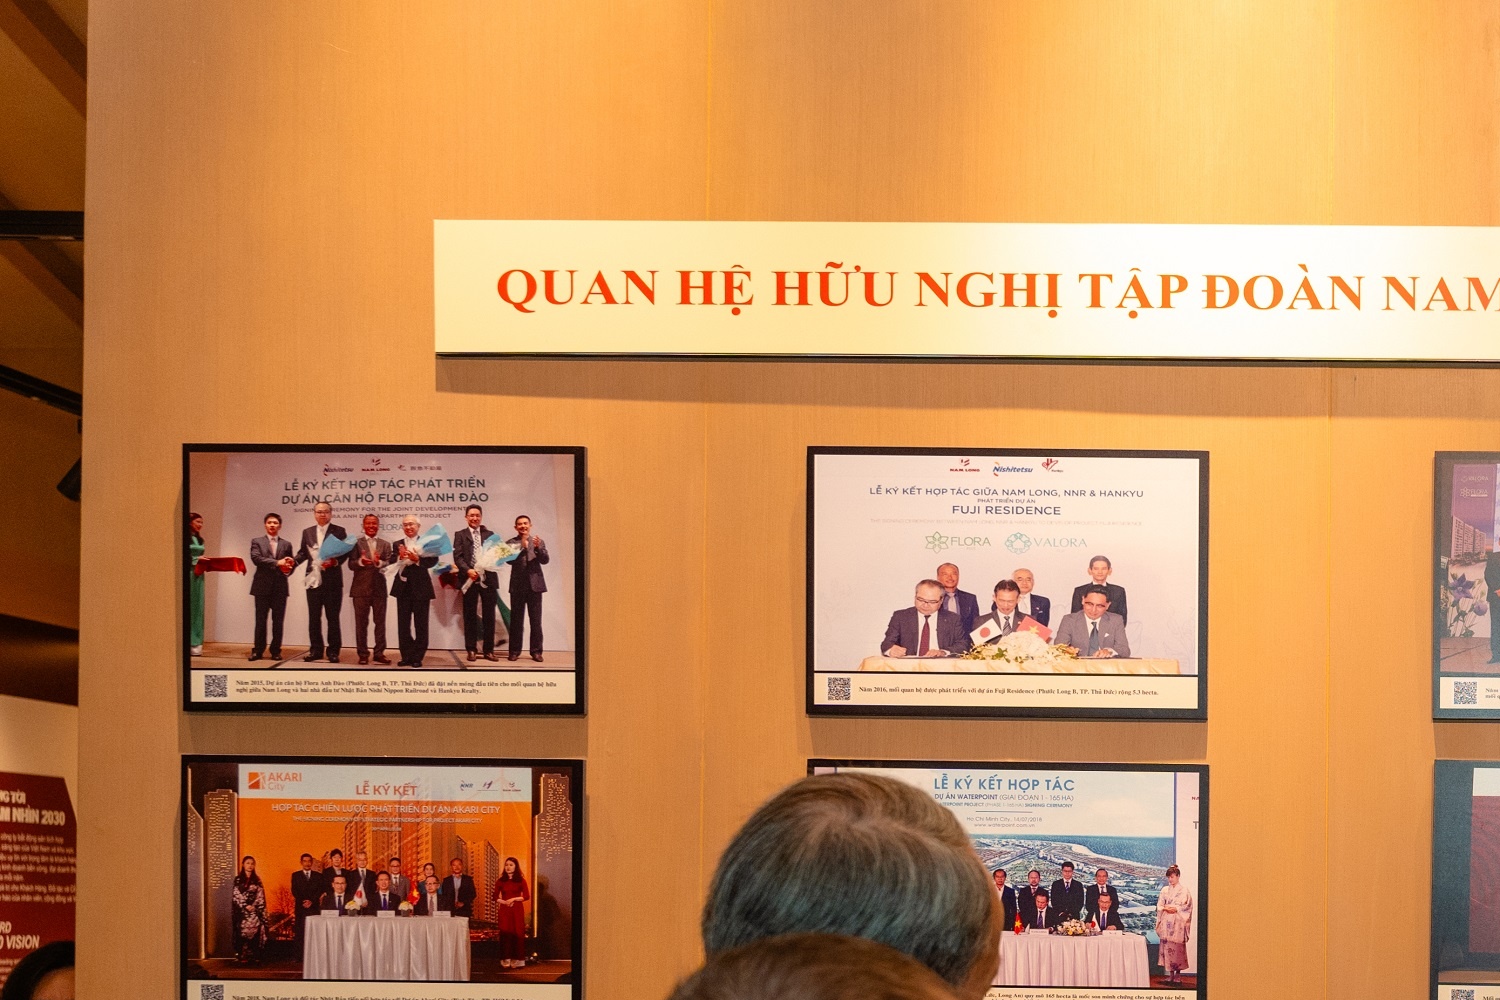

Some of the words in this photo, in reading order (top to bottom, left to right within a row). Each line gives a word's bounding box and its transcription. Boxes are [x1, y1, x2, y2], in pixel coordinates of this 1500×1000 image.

[497, 269, 659, 313] QUAN
[676, 264, 754, 316] HỆ
[771, 262, 898, 307] HỮU
[914, 271, 1063, 318] NGHỊ
[1078, 268, 1189, 318] TẬP
[1202, 264, 1365, 311] ĐOÀN
[993, 466, 1033, 474] Nishitetsu
[284, 478, 299, 491] LỄ
[302, 479, 318, 490] KÝ
[322, 478, 345, 490] KẾT
[349, 481, 376, 492] HỢP
[380, 478, 405, 489] TÁC
[409, 478, 442, 489] PHÁT
[447, 476, 486, 488] TRIỂN
[869, 485, 882, 494] LỄ
[885, 486, 899, 495] KÝ
[902, 485, 922, 495] KẾT
[925, 488, 948, 497] HỢP
[950, 486, 970, 495] TÁC
[972, 487, 998, 496] GIỮA
[1029, 489, 1060, 497] LONG,
[282, 495, 300, 506] DỰ
[303, 493, 322, 504] ÁN
[322, 492, 351, 504] CĂN
[355, 492, 374, 505] HỘ
[378, 494, 422, 503] FLORA
[426, 493, 455, 502] ANH
[459, 490, 489, 502] ĐÀO
[952, 506, 980, 514] FUJI
[985, 506, 1061, 515] RESIDENCE
[950, 537, 991, 546] FLORA
[1034, 538, 1087, 548] VALORA
[268, 772, 302, 782] AKARI
[934, 774, 948, 789] LỄ
[954, 776, 972, 789] KÝ
[978, 775, 1002, 790] KẾT
[1008, 779, 1039, 792] HỢP
[1045, 777, 1075, 790] TÁC
[268, 783, 284, 791] City
[356, 781, 369, 795] LỄ
[373, 783, 390, 795] KÝ
[393, 782, 417, 796] KẾT
[452, 805, 479, 814] AKARI
[481, 805, 501, 814] CITY
[41, 810, 65, 826] 2030
[7, 934, 40, 950] VISION
